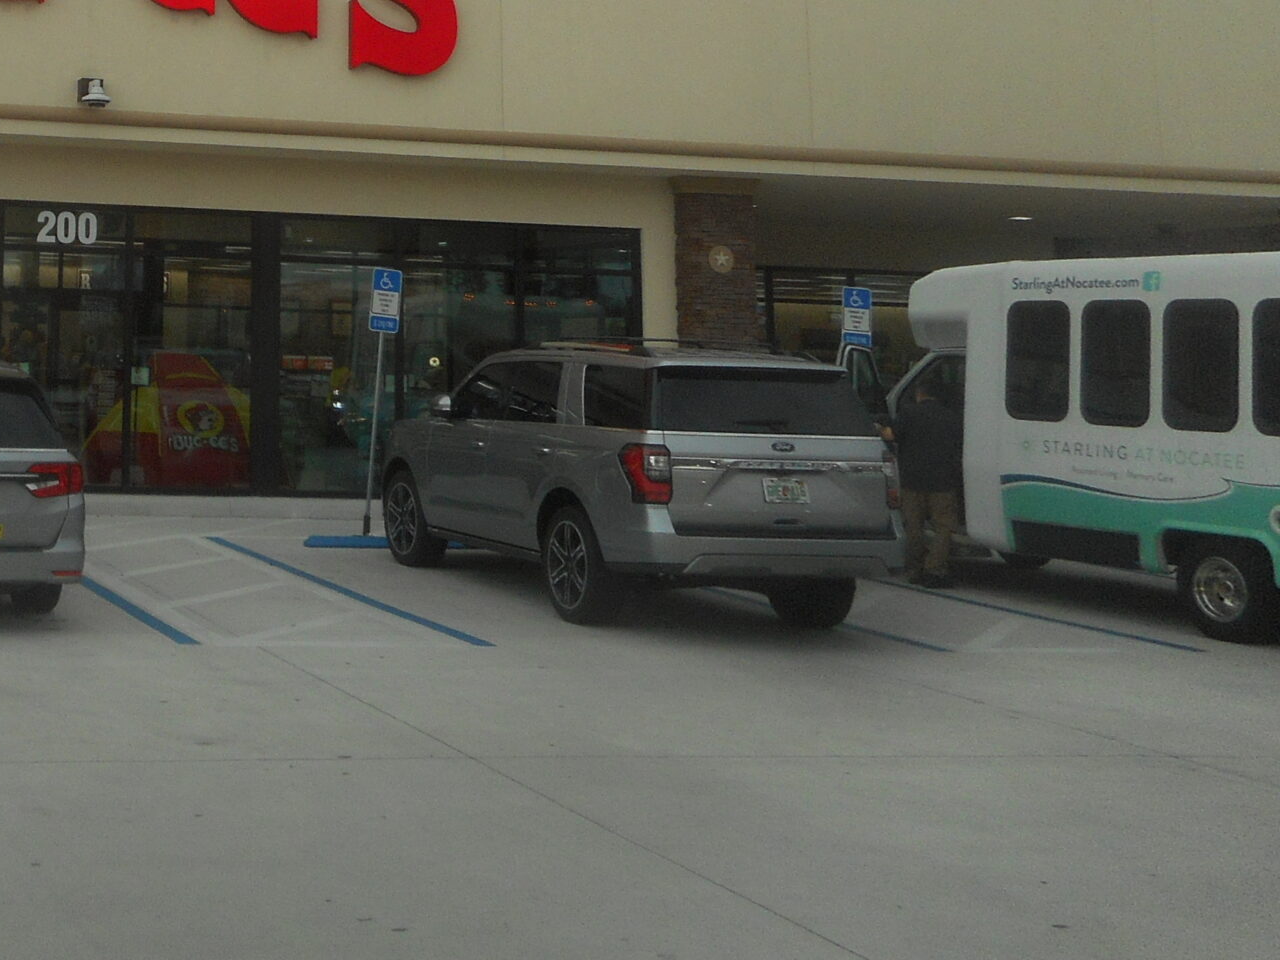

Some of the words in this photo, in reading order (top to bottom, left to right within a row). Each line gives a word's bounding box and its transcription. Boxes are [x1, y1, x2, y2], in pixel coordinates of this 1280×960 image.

[37, 210, 98, 245] 200
[1012, 276, 1140, 294] StarlingAtNocatee.com
[1042, 439, 1128, 460] STARLING
[1134, 448, 1152, 462] AT
[1159, 448, 1245, 470] NOCATEE
